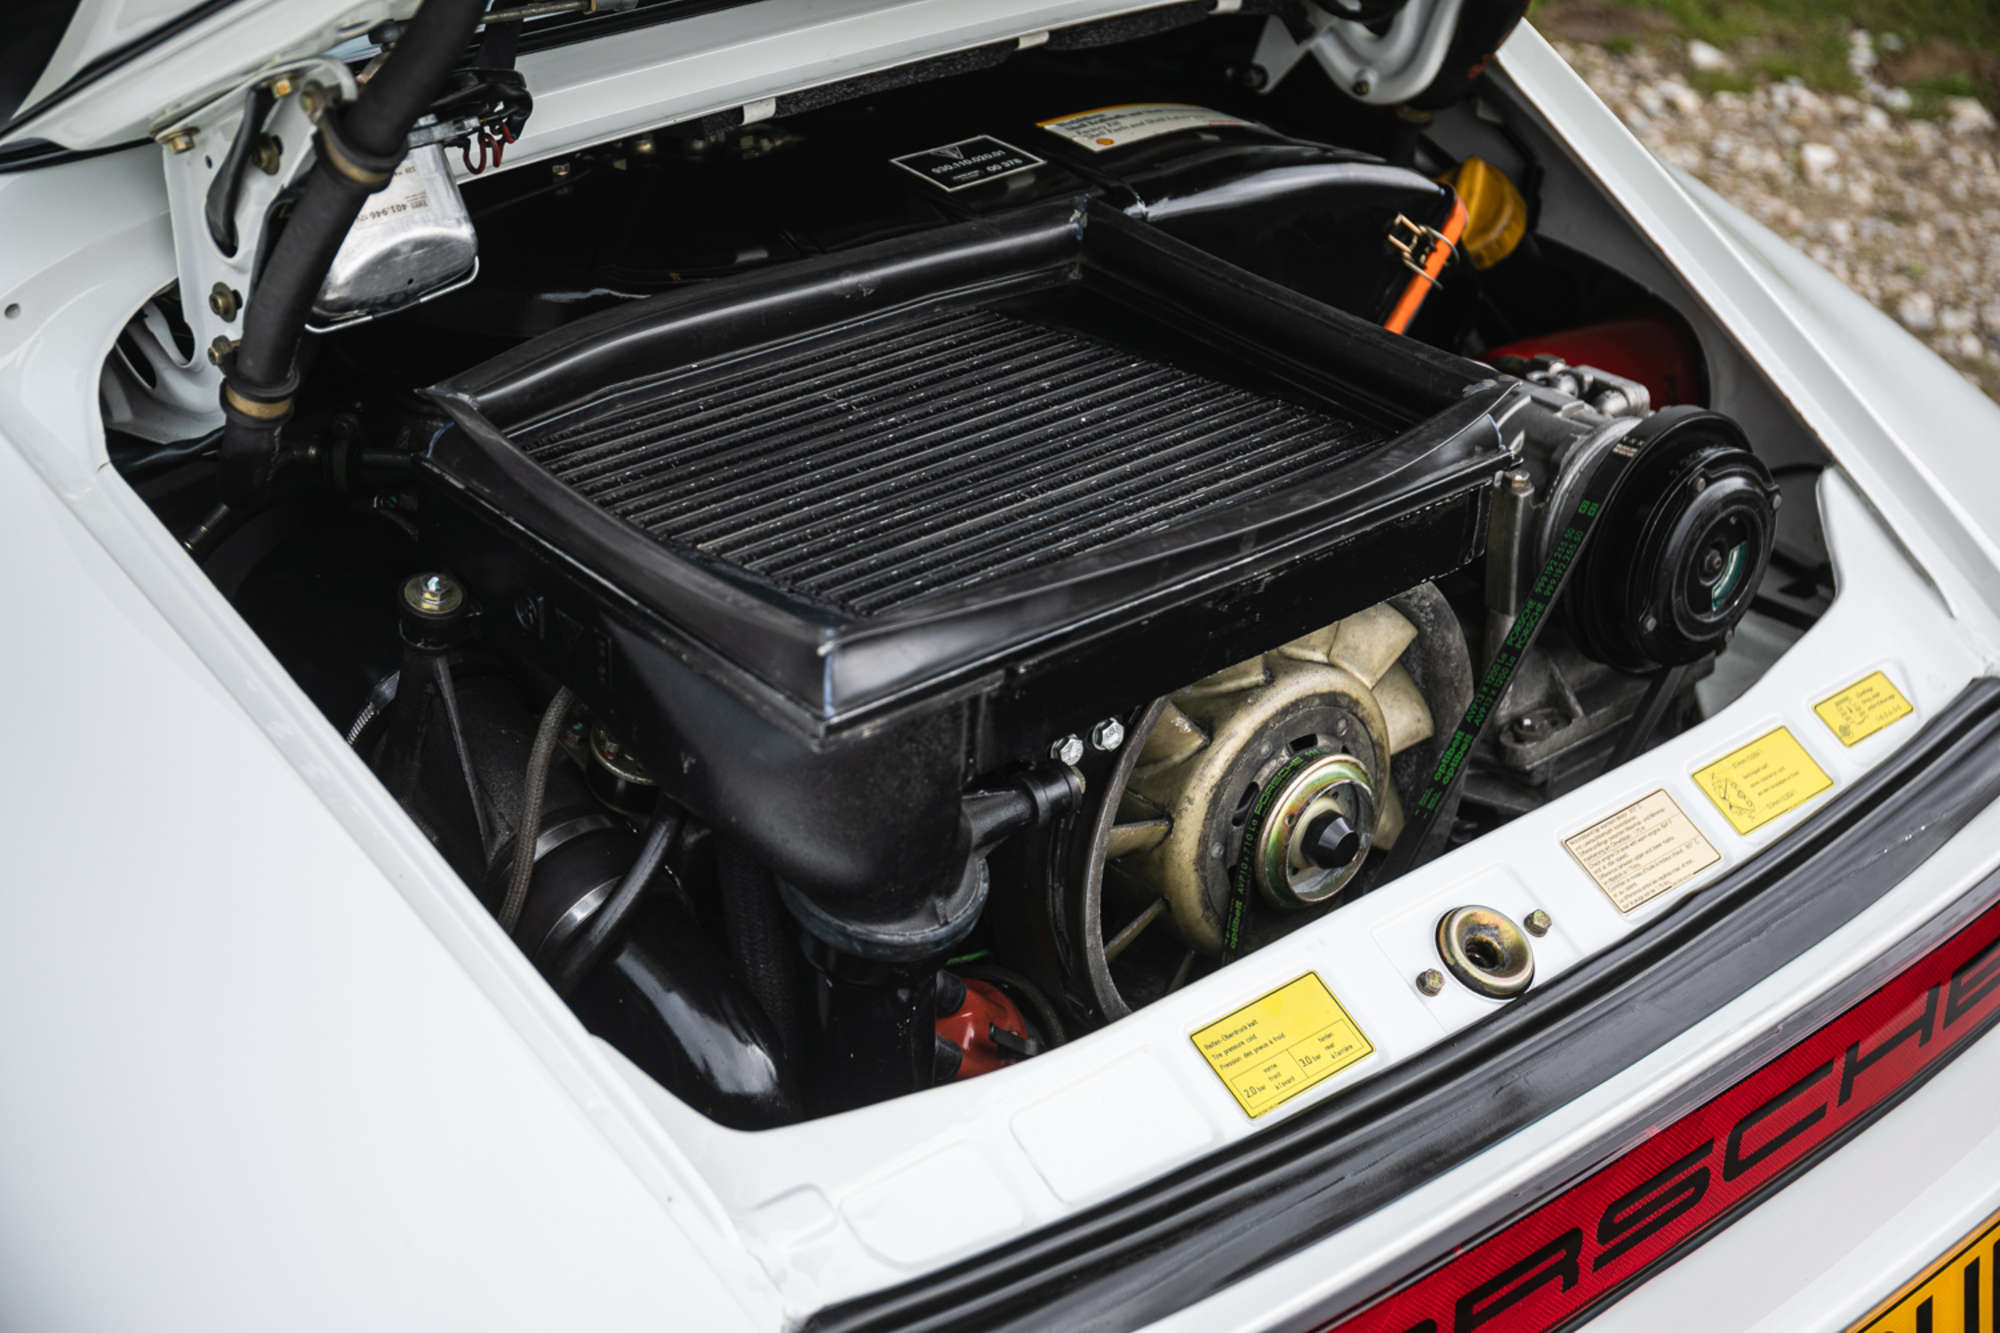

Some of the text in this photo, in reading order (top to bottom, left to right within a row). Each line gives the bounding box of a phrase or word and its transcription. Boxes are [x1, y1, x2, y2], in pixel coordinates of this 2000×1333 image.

[1434, 730, 1465, 781] optibelt
[1506, 600, 1536, 646] PORSCHE
[1442, 734, 1474, 785] optibelt
[1514, 602, 1546, 648] PORSCHE
[1223, 1040, 1244, 1055] pressure
[1403, 936, 2000, 1333] RSCHE
